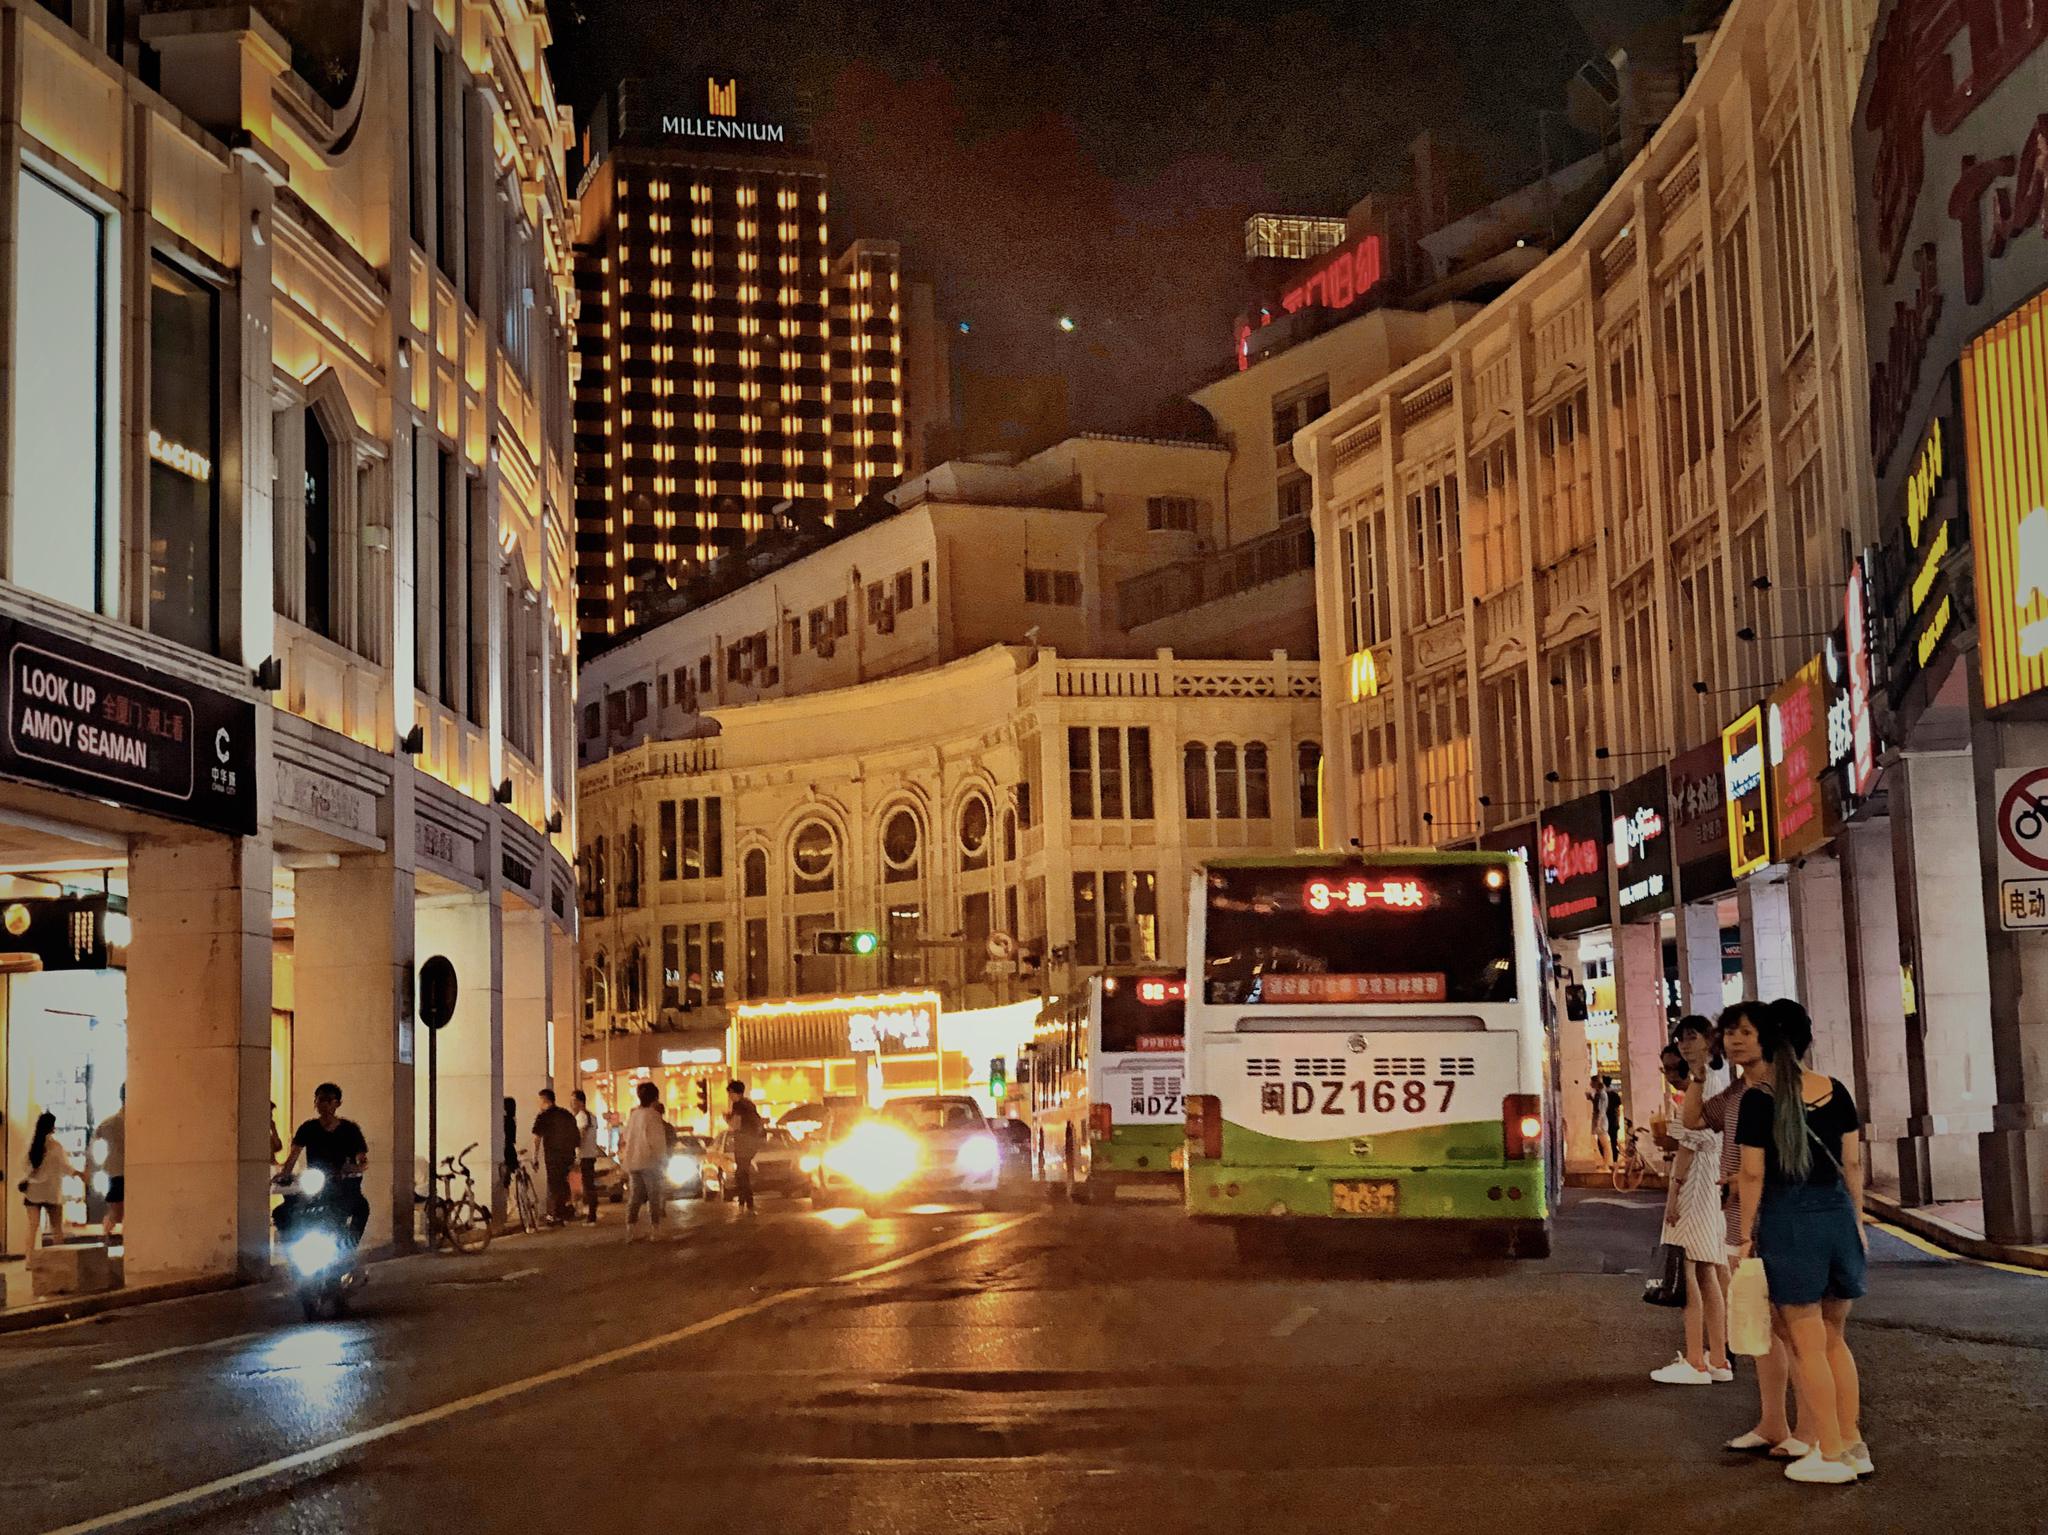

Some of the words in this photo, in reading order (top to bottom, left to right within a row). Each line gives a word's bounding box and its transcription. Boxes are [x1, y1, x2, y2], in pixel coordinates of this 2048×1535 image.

[662, 115, 784, 142] MILLENNIUM
[22, 665, 69, 706] LOOK
[73, 683, 96, 713] UP
[21, 707, 74, 748] AMOY
[77, 723, 148, 769] SEAMAN
[2009, 887, 2046, 919] 电动
[1261, 1079, 1456, 1116] 闽DZ1687
